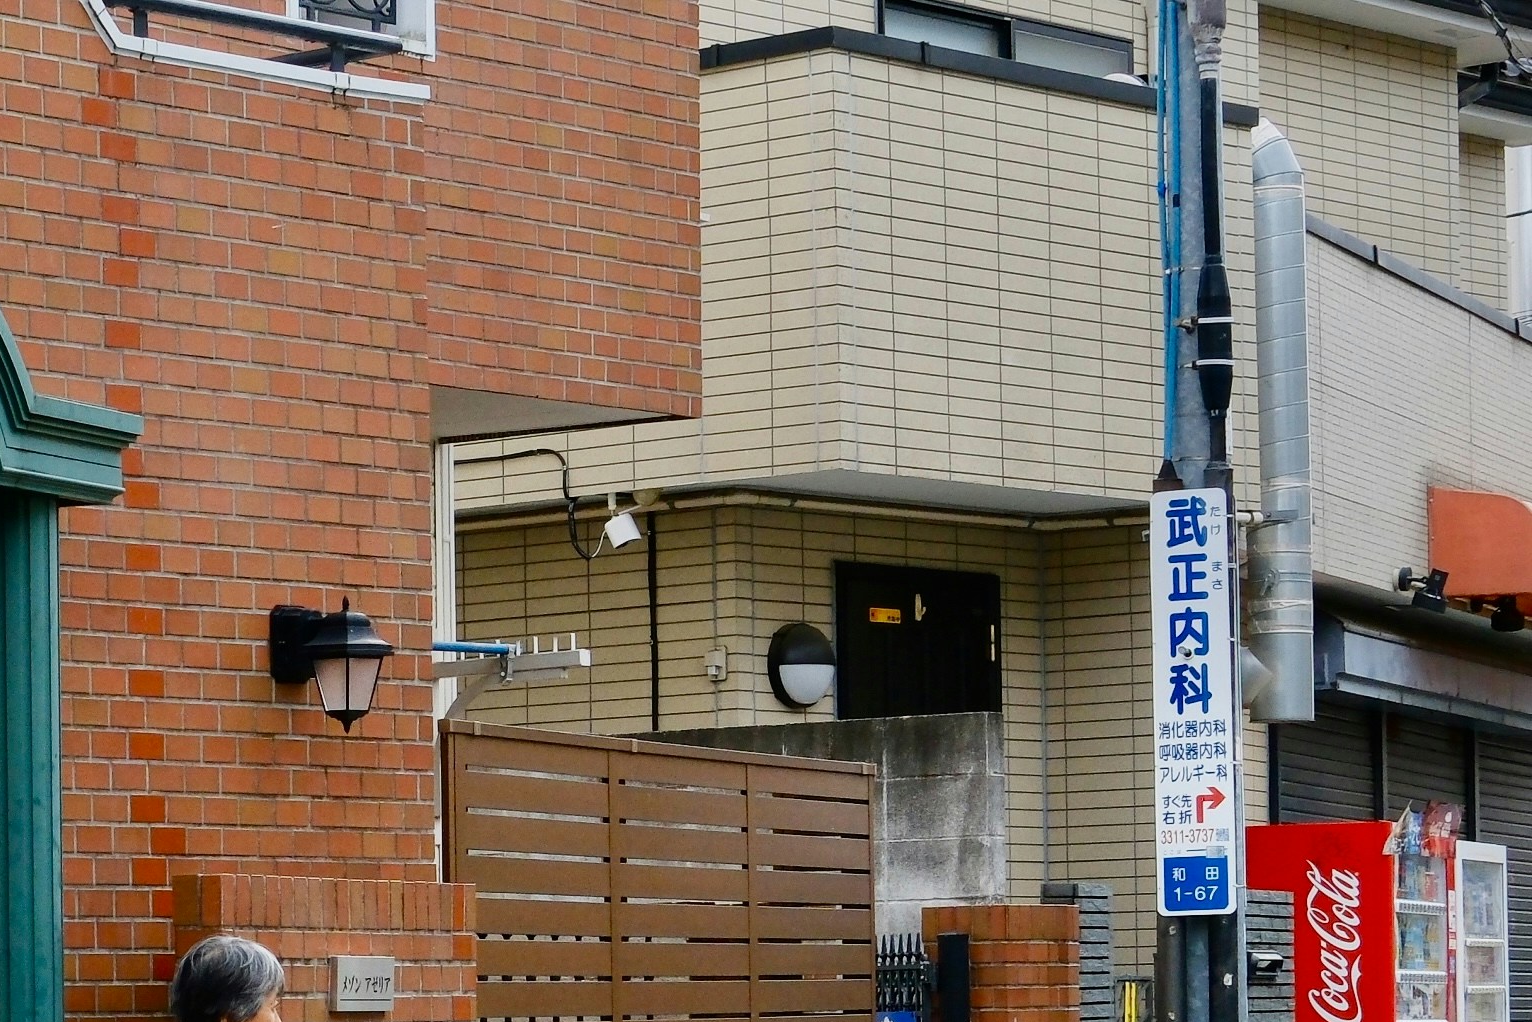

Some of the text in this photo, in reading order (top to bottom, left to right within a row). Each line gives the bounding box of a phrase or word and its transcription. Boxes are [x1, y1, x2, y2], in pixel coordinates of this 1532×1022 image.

[1210, 506, 1223, 590] たけ まさ
[1165, 496, 1213, 715] 武正内科
[1158, 719, 1228, 739] 消化器内科
[1158, 742, 1228, 762] 呼吸器内科
[1159, 764, 1228, 783] アレルギー科
[1162, 794, 1193, 808] すぐ先
[1162, 810, 1193, 825] 右折
[1160, 828, 1214, 845] 3311-3737
[1171, 866, 1220, 882] 和田
[1173, 885, 1219, 902] 1-67
